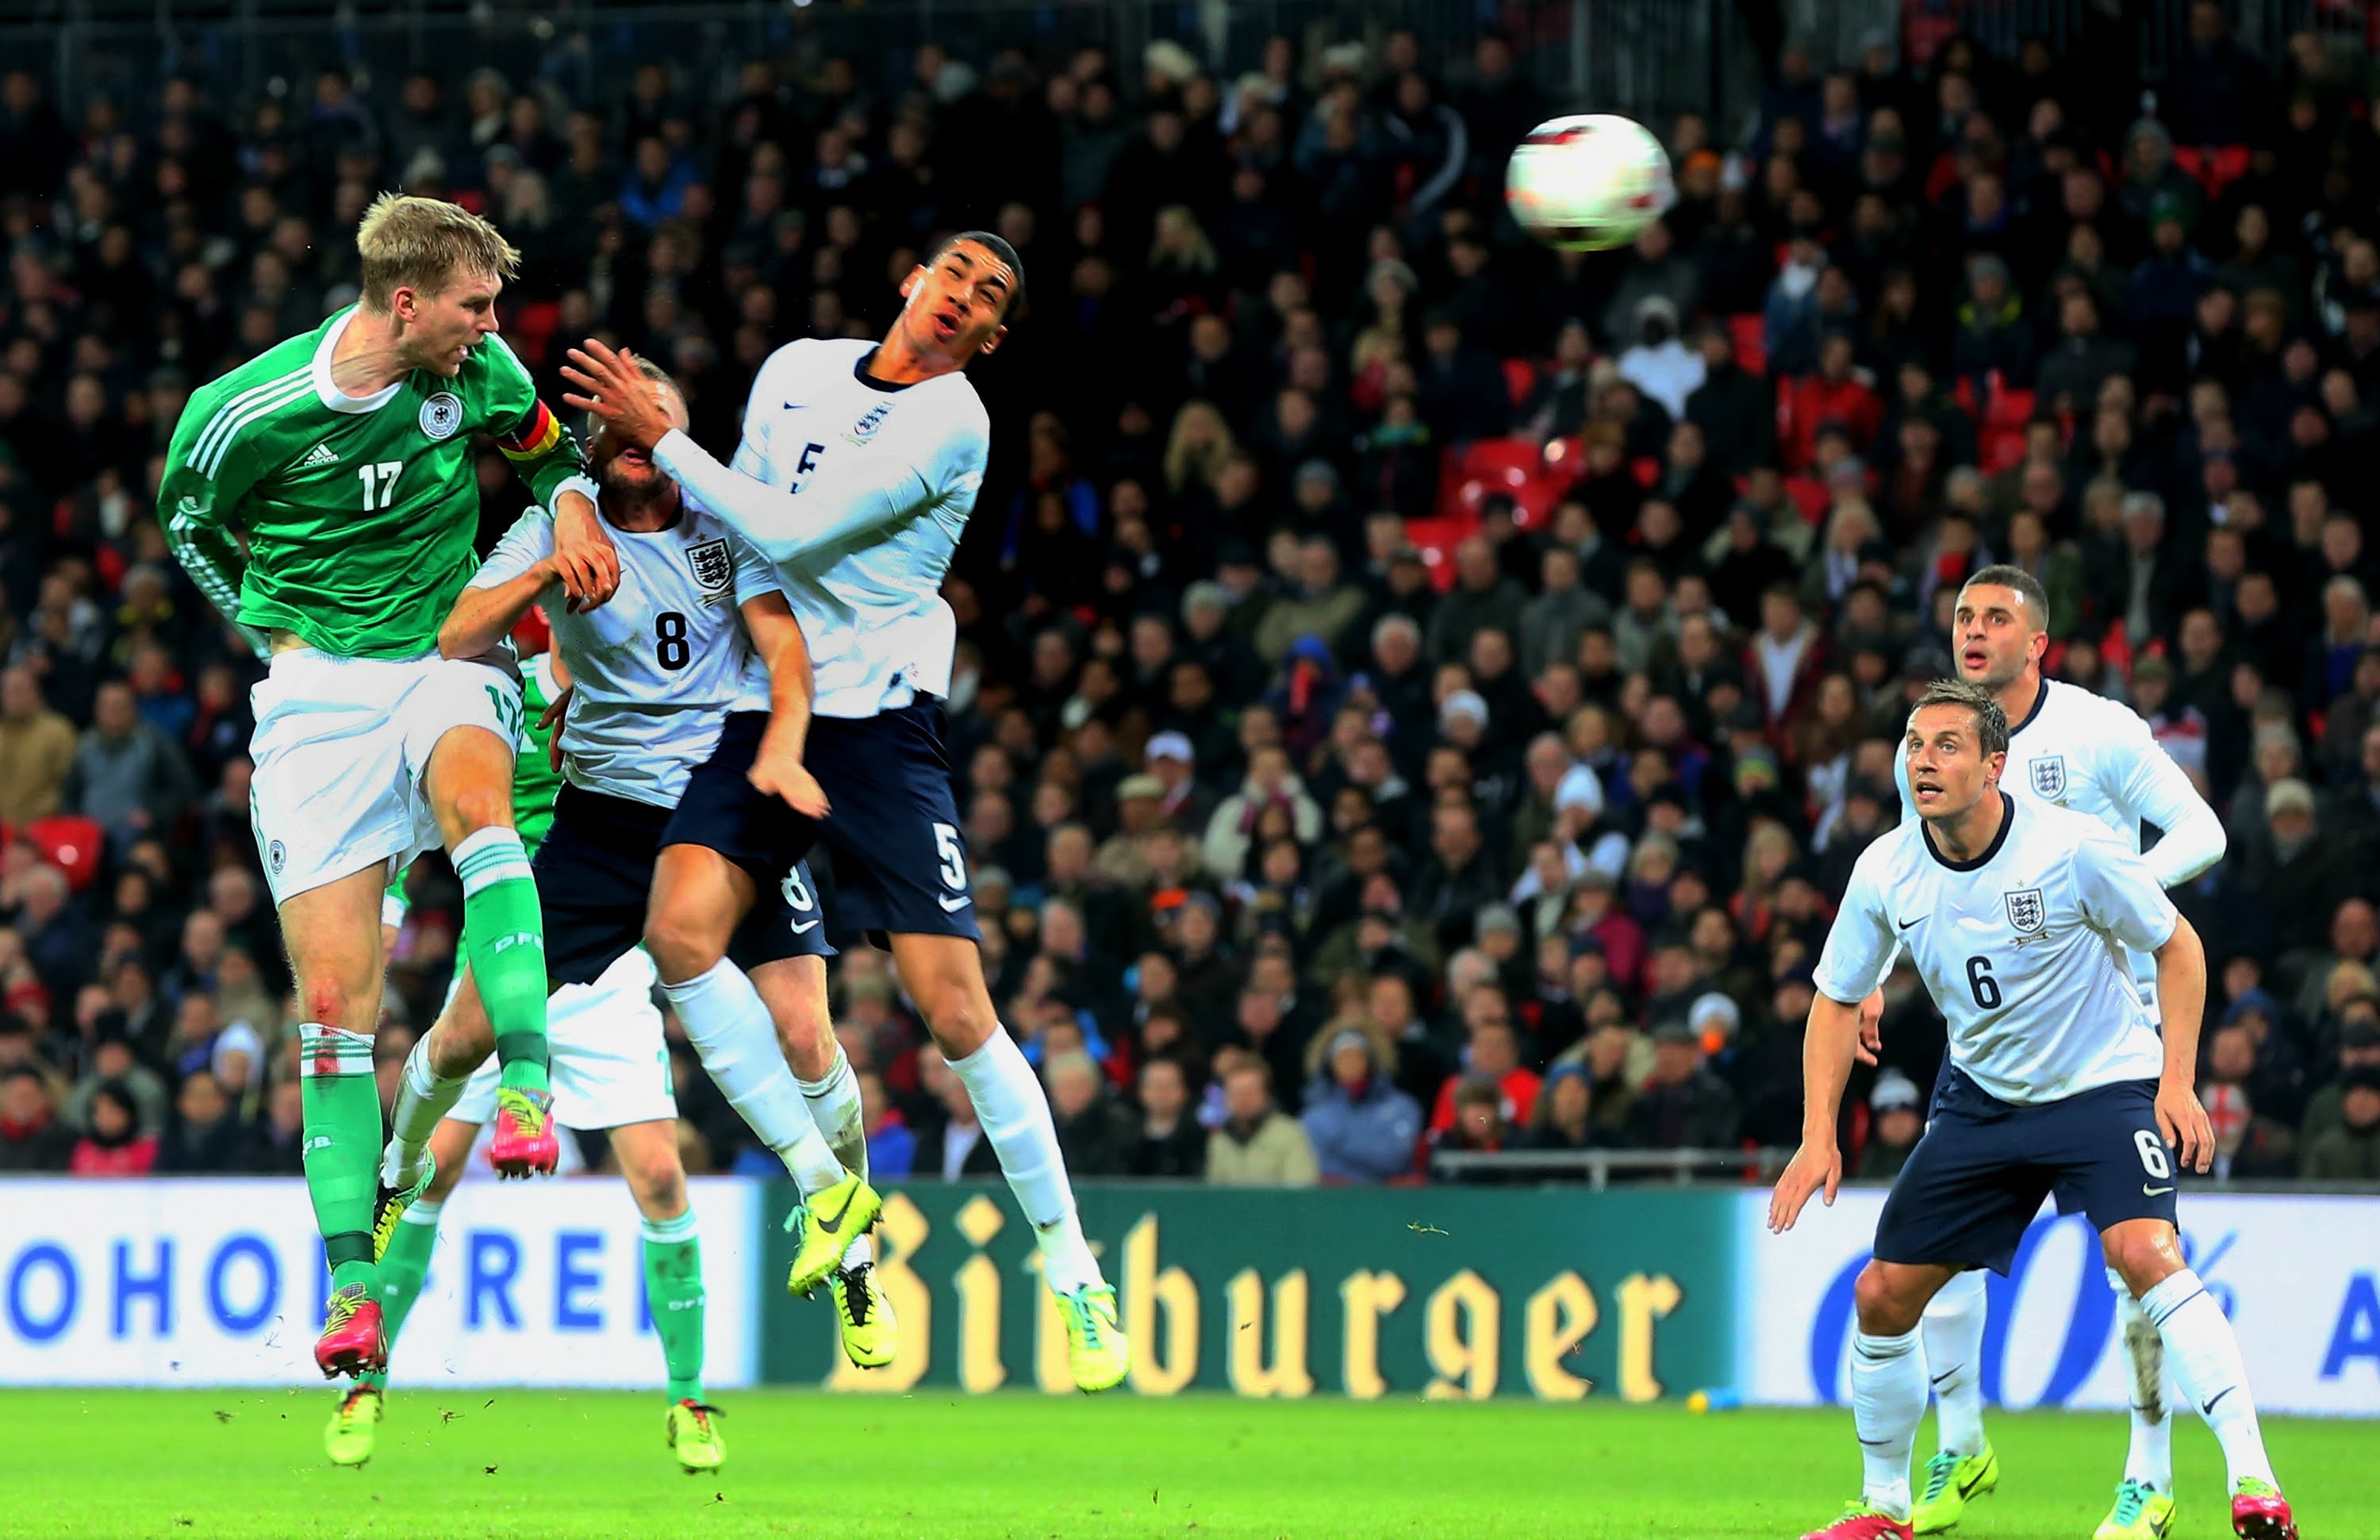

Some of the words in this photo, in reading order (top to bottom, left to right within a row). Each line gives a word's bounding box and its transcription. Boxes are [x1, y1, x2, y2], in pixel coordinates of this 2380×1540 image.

[358, 460, 403, 512] 17
[655, 611, 690, 671] 8
[931, 822, 967, 891] 5
[1965, 954, 2002, 1010] 6
[2133, 1129, 2171, 1180] 6
[7, 1231, 654, 1342] OHORE
[2318, 1271, 2380, 1379] A
